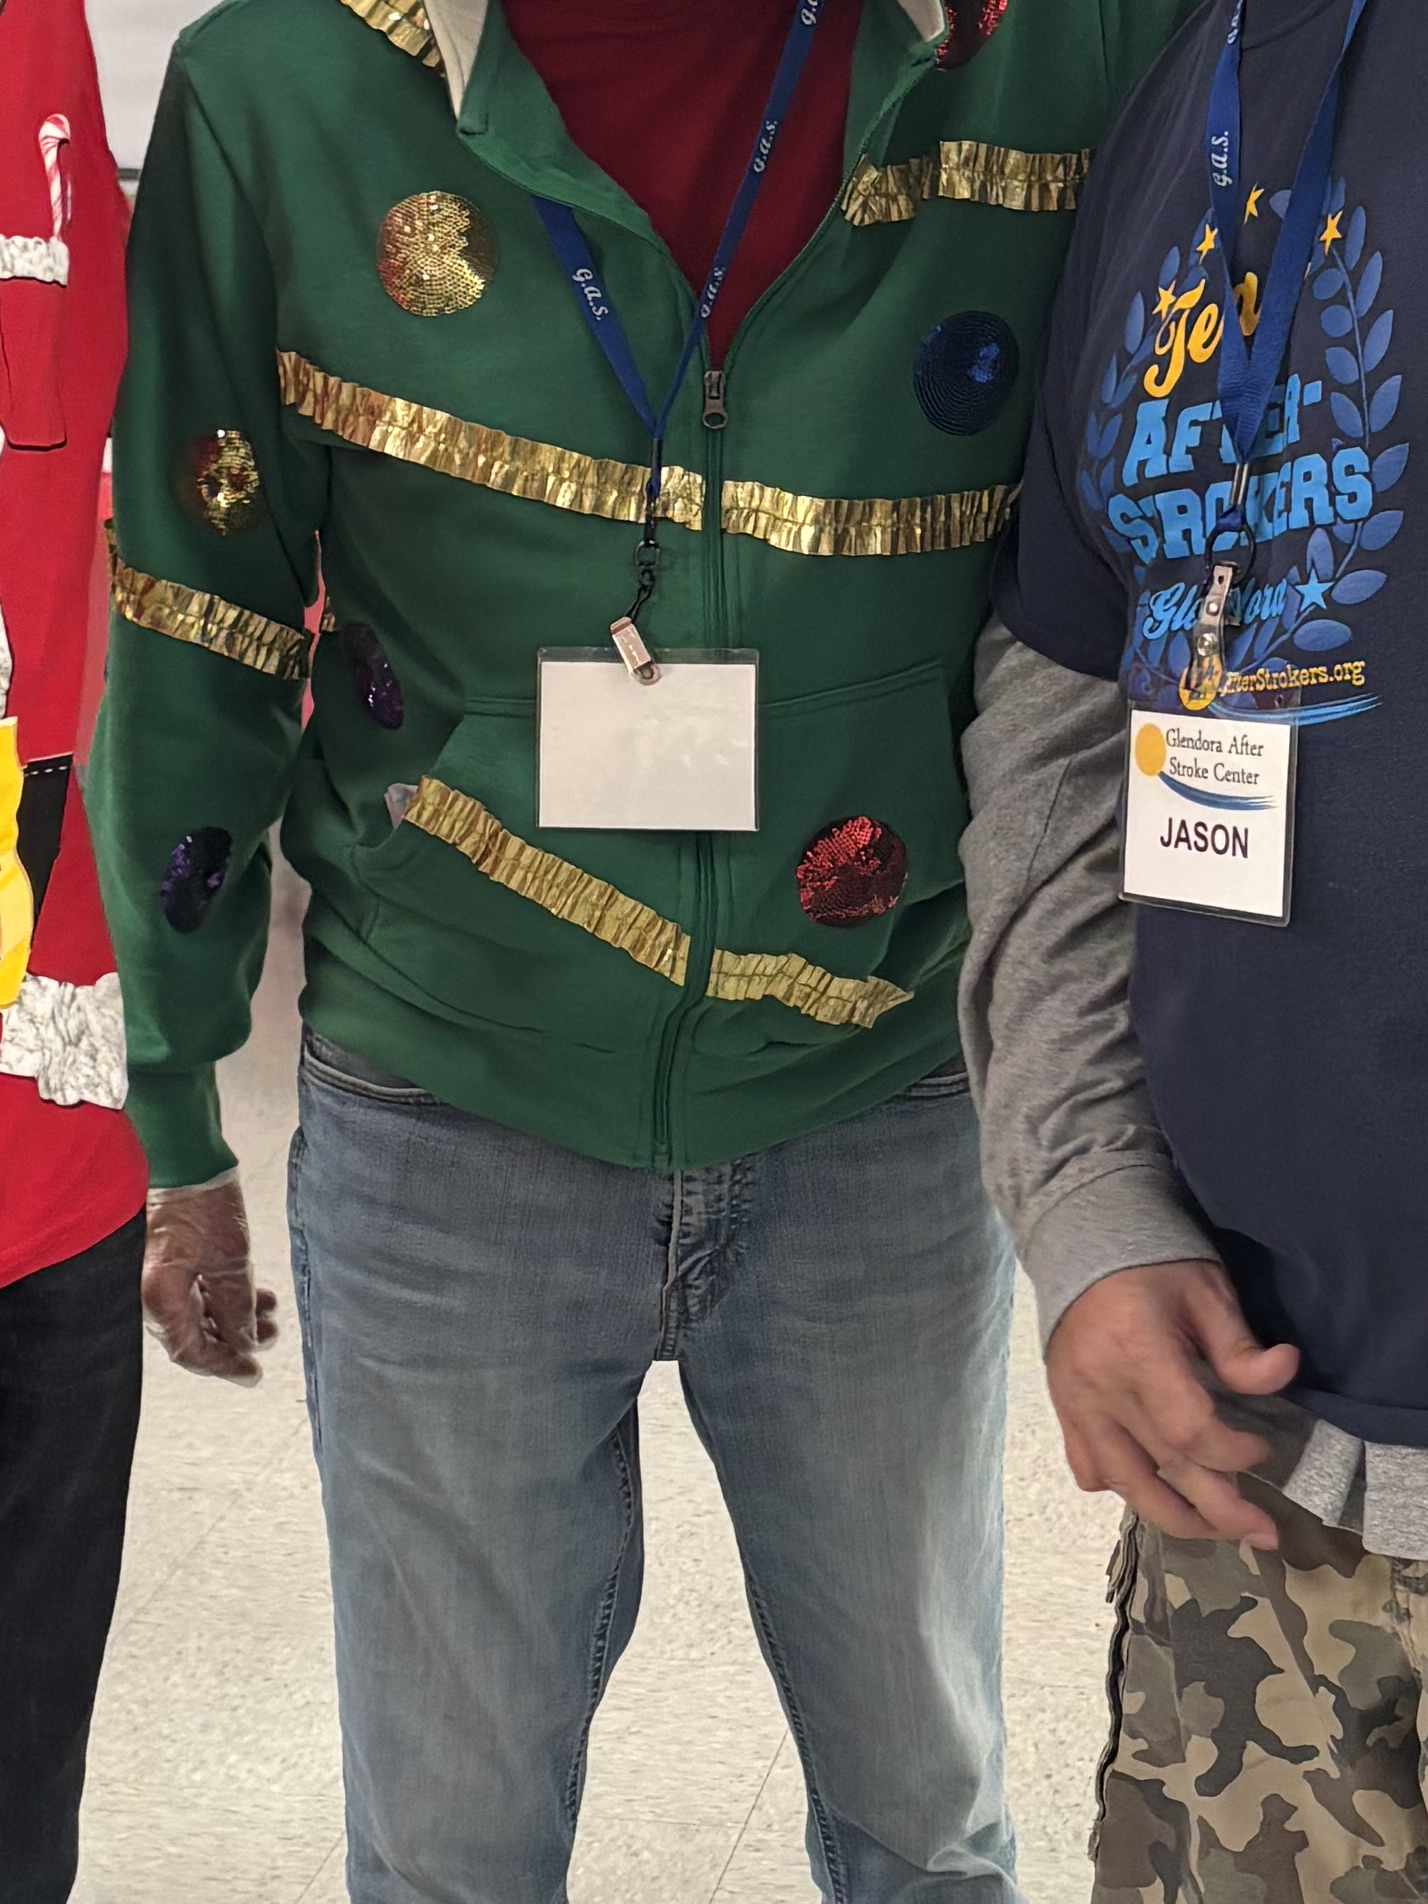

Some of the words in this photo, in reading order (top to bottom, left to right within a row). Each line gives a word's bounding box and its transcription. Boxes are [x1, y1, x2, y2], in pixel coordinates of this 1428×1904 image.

[1143, 576, 1287, 640] Gleora
[1165, 728, 1223, 753] Glendora
[1228, 734, 1264, 757] After
[1169, 756, 1209, 780] Stroke
[1213, 762, 1260, 785] Center
[1160, 816, 1249, 859] JASON
